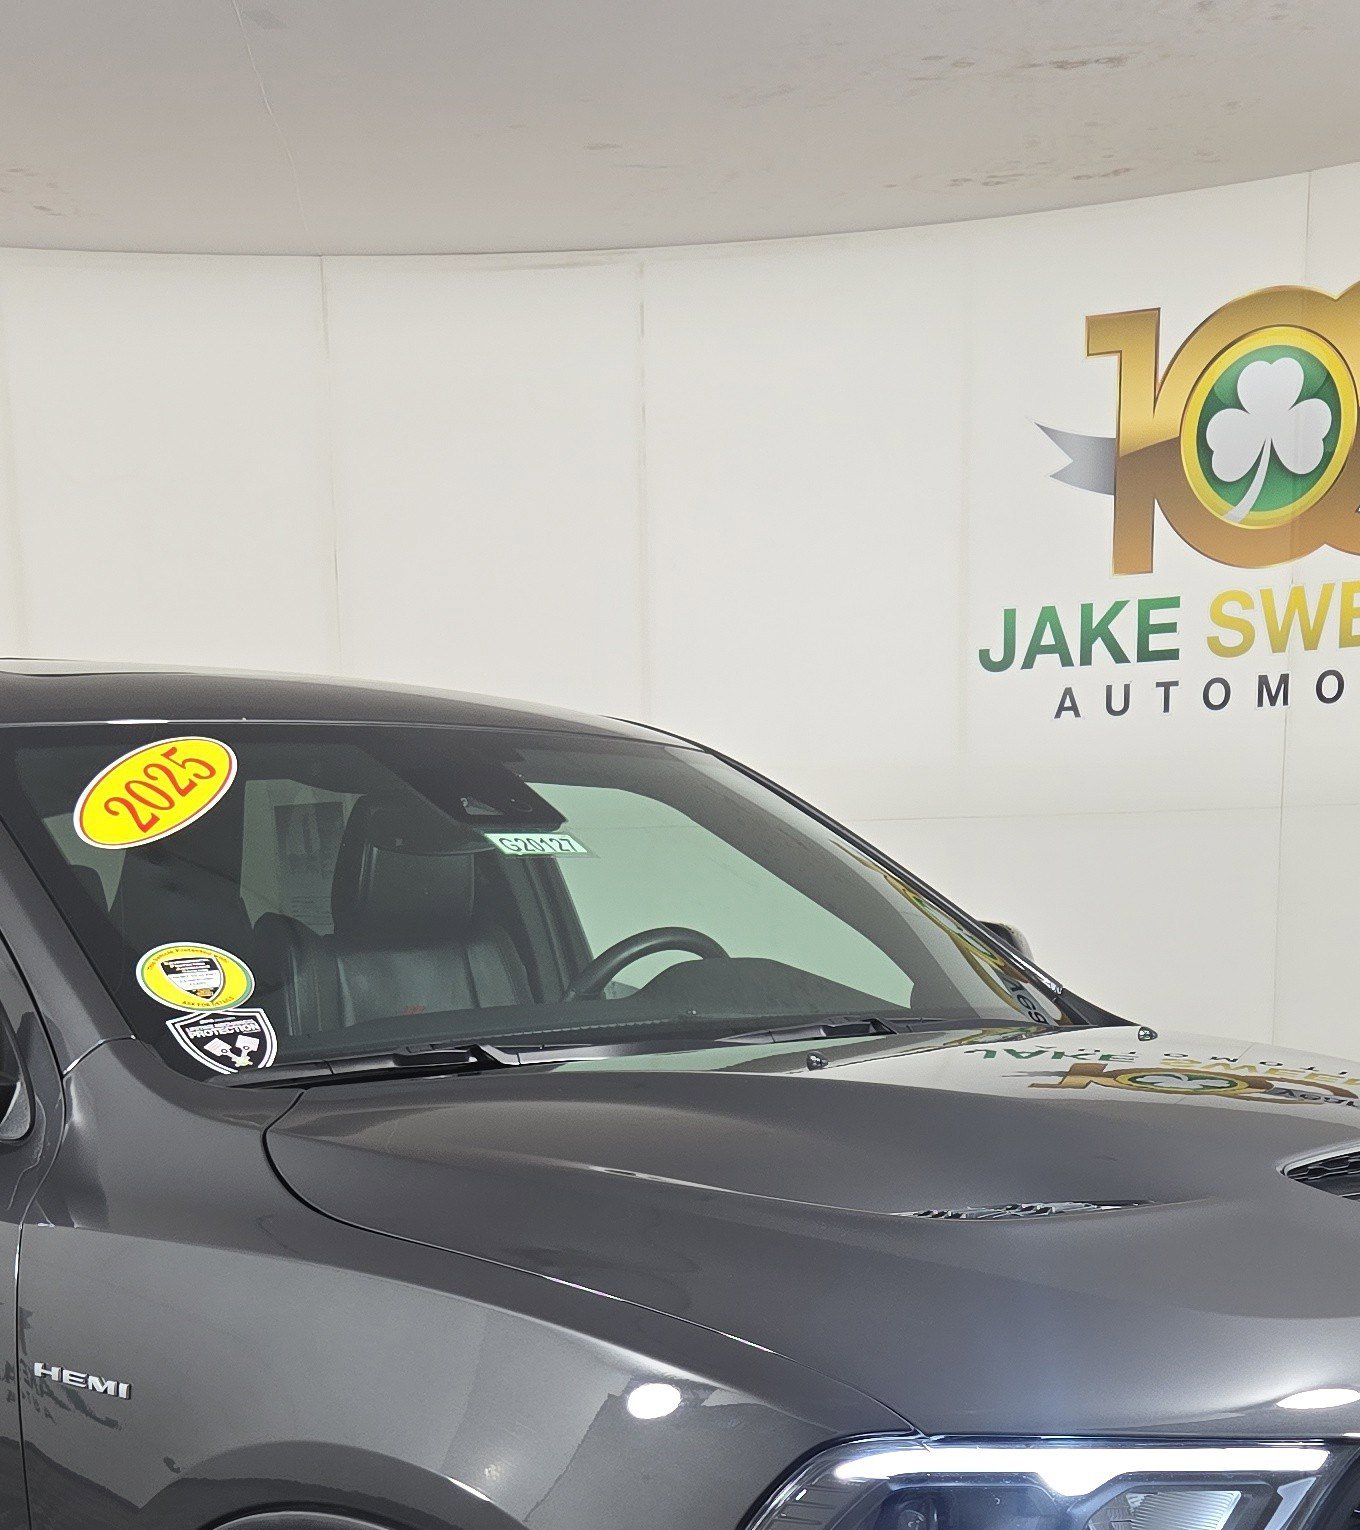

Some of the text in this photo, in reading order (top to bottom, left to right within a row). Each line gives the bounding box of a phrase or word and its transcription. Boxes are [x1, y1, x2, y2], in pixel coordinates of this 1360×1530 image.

[978, 595, 1182, 673] JAKE
[104, 747, 217, 833] 2025
[499, 838, 578, 853] G20127
[34, 1362, 131, 1400] HEMI
